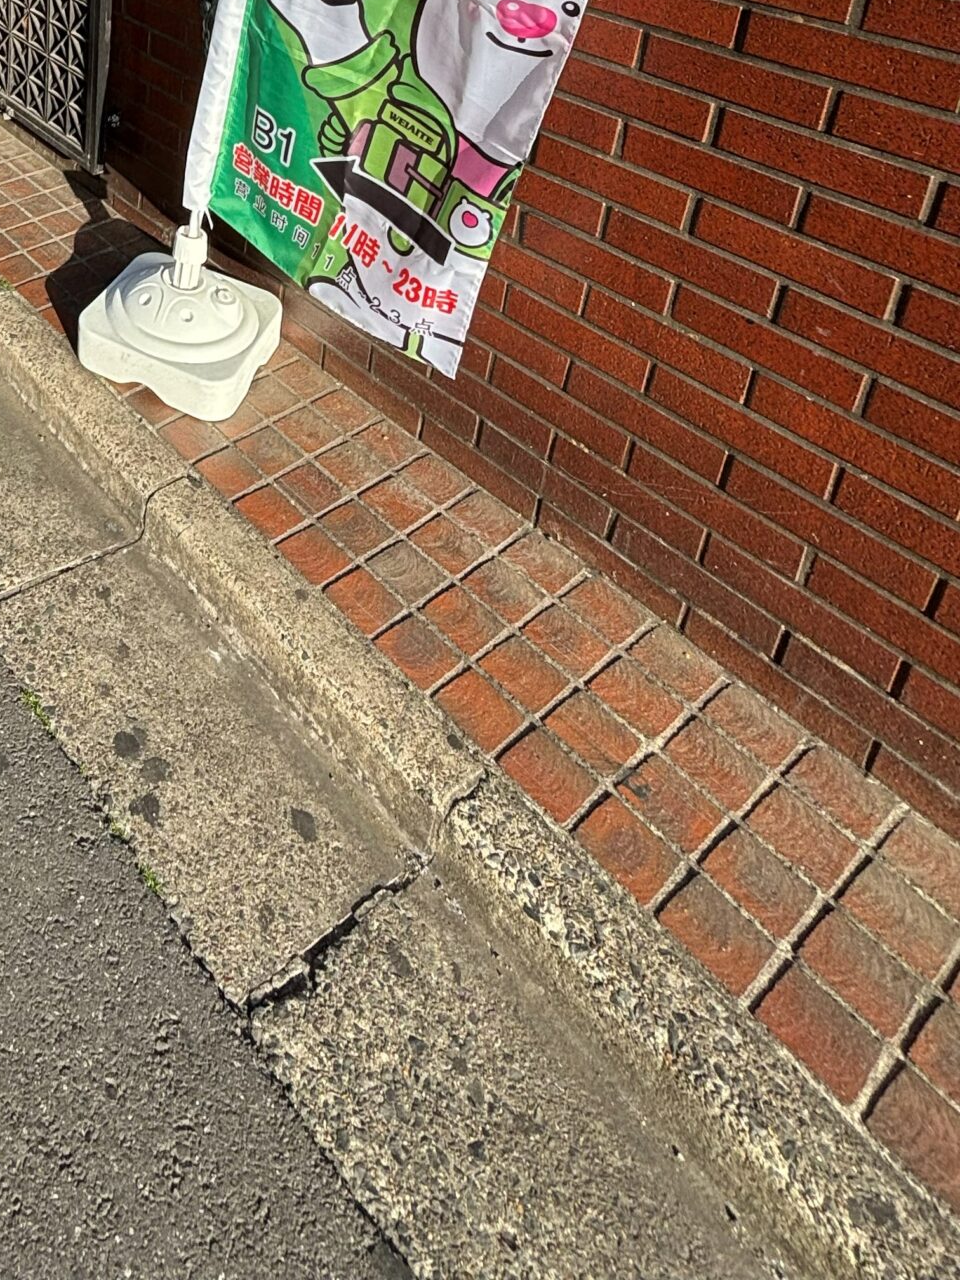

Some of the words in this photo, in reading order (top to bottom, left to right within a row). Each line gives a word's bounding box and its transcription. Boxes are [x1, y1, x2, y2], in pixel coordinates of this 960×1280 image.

[254, 108, 294, 166] B1
[233, 144, 324, 225] 営業時間
